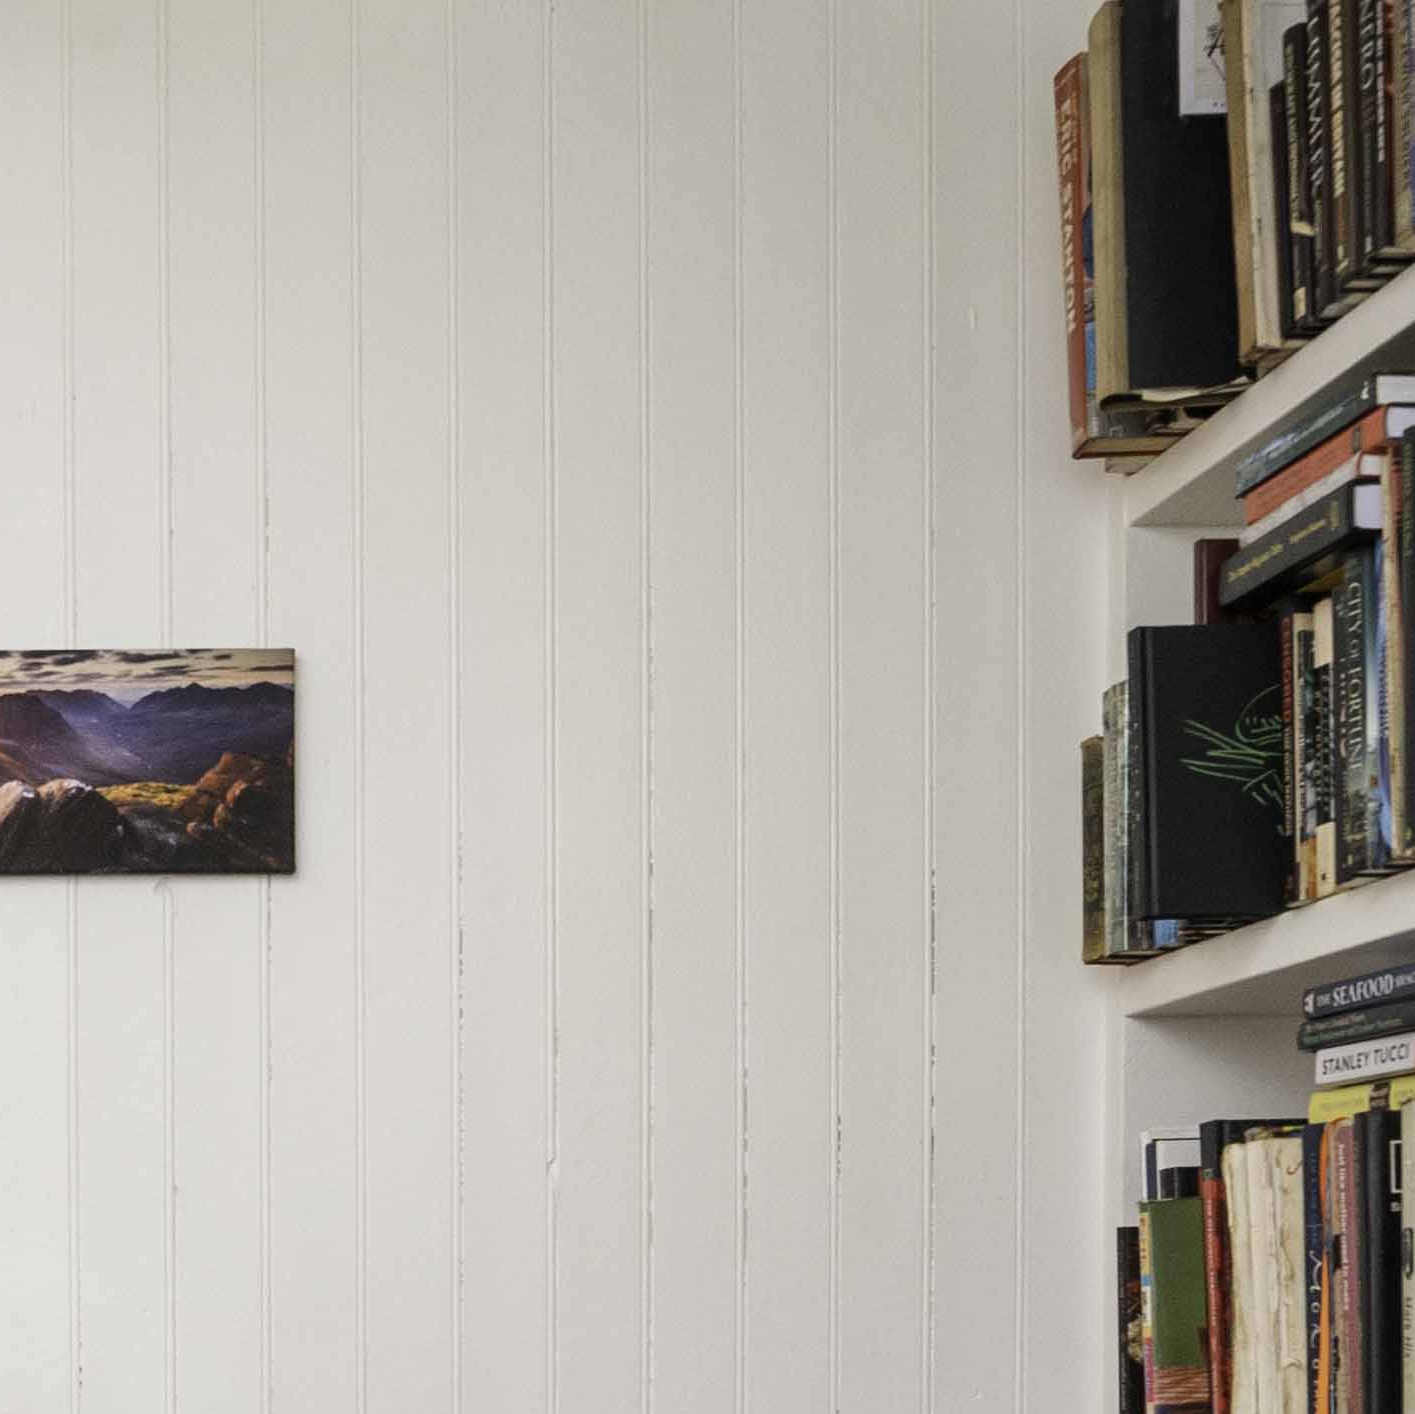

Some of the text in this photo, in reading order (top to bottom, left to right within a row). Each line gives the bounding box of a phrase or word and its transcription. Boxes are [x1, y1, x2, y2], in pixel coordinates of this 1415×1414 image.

[1062, 180, 1076, 334] STANTON
[1347, 582, 1363, 634] CITY
[1333, 974, 1394, 1007] SEAFOOD
[1322, 1043, 1411, 1076] STANLEY TUCCI
